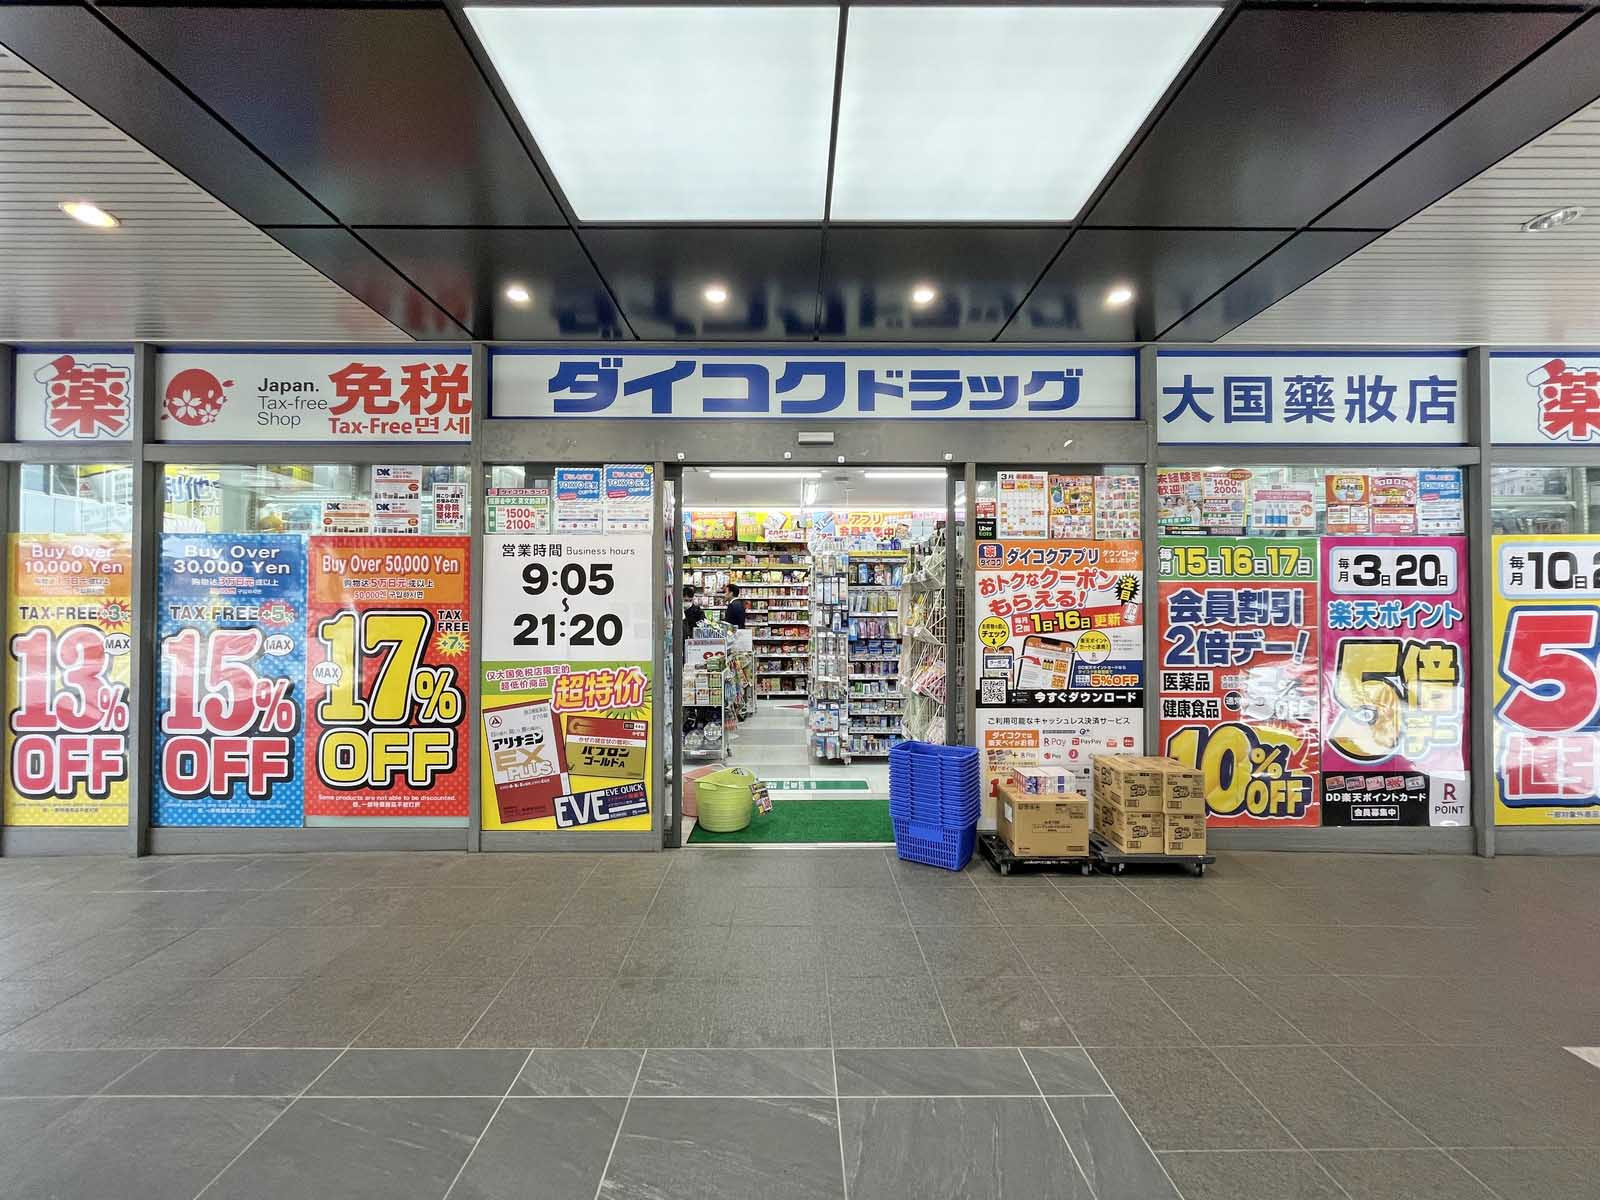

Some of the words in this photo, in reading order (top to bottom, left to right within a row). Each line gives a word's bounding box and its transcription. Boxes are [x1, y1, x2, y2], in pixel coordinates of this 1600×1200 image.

[257, 378, 320, 395] Japan.
[328, 362, 472, 416] 免税
[548, 358, 1084, 413] ダイコクドラッグ
[50, 355, 128, 434] 薬
[257, 396, 328, 410] Tax-free
[1162, 374, 1457, 424] 大国藥妝店
[257, 411, 301, 428] Shop
[328, 417, 412, 434] Tax-Free
[31, 544, 64, 560] Buy
[72, 545, 114, 559] Over
[184, 544, 223, 560] Buy
[230, 545, 281, 559] Over
[502, 543, 562, 558] 営業時間
[566, 546, 607, 556] Business
[609, 546, 635, 556] hours
[1007, 548, 1099, 565] ダイコクアプリ
[24, 560, 83, 574] 10,000
[89, 560, 123, 574] Yen
[173, 560, 244, 575] 30,000
[251, 560, 291, 574] Yen
[322, 555, 347, 574] Buy
[350, 555, 381, 573] Over
[385, 555, 430, 573] 50,000
[433, 555, 459, 573] Yen
[1159, 547, 1172, 575] 毎月
[1338, 557, 1350, 583] 毎月
[1508, 555, 1524, 586] 毎月
[1527, 551, 1588, 590] 10日
[522, 563, 615, 596] 9:05
[978, 567, 1118, 595] おトクなクーポン
[1120, 575, 1136, 602] 注目
[988, 590, 1087, 618] もらえる!
[1167, 588, 1304, 627] 会員割引
[19, 606, 97, 620] TAX-FREE
[170, 605, 259, 621] TAX-FREE
[438, 610, 462, 620] TAX
[1327, 599, 1463, 630] 楽天ポイント
[438, 622, 469, 632] FREE
[513, 613, 624, 646] 21:20
[982, 630, 1007, 638] チェック
[104, 638, 130, 650] MAX
[264, 639, 292, 650] MAX
[1164, 625, 1310, 668] 2倍デー!
[314, 666, 340, 679] MAX
[319, 610, 463, 725] 17%
[486, 664, 571, 681] 仅大国免税店限定的
[12, 628, 127, 731] 13%
[162, 628, 296, 735] 15%
[500, 678, 548, 691] 超低价商品
[1091, 674, 1139, 687] 5%OFF
[1163, 672, 1210, 692] 医薬品
[553, 669, 645, 711] 超特价
[1034, 692, 1137, 703] 今すぐダウンロード
[1163, 699, 1220, 719] 健康食品
[987, 716, 1131, 726] ご利用可能なキャッシュレス決済サービス
[492, 732, 543, 751] アリナミン
[1080, 738, 1103, 747] PayPay
[319, 729, 455, 787] OFF
[495, 744, 545, 772] EX
[581, 746, 631, 758] パブロン
[14, 736, 126, 795] OFF
[164, 736, 290, 796] OFF
[583, 756, 626, 768] ゴールドA
[605, 788, 619, 797] EVE
[620, 783, 644, 793] QUICK
[1246, 779, 1305, 816] OFF
[1325, 792, 1427, 803] DD楽天ポイントカード
[1442, 783, 1458, 801] R
[554, 791, 610, 828] EVE
[1354, 807, 1397, 818] 会員募集中
[1434, 805, 1465, 815] POINT
